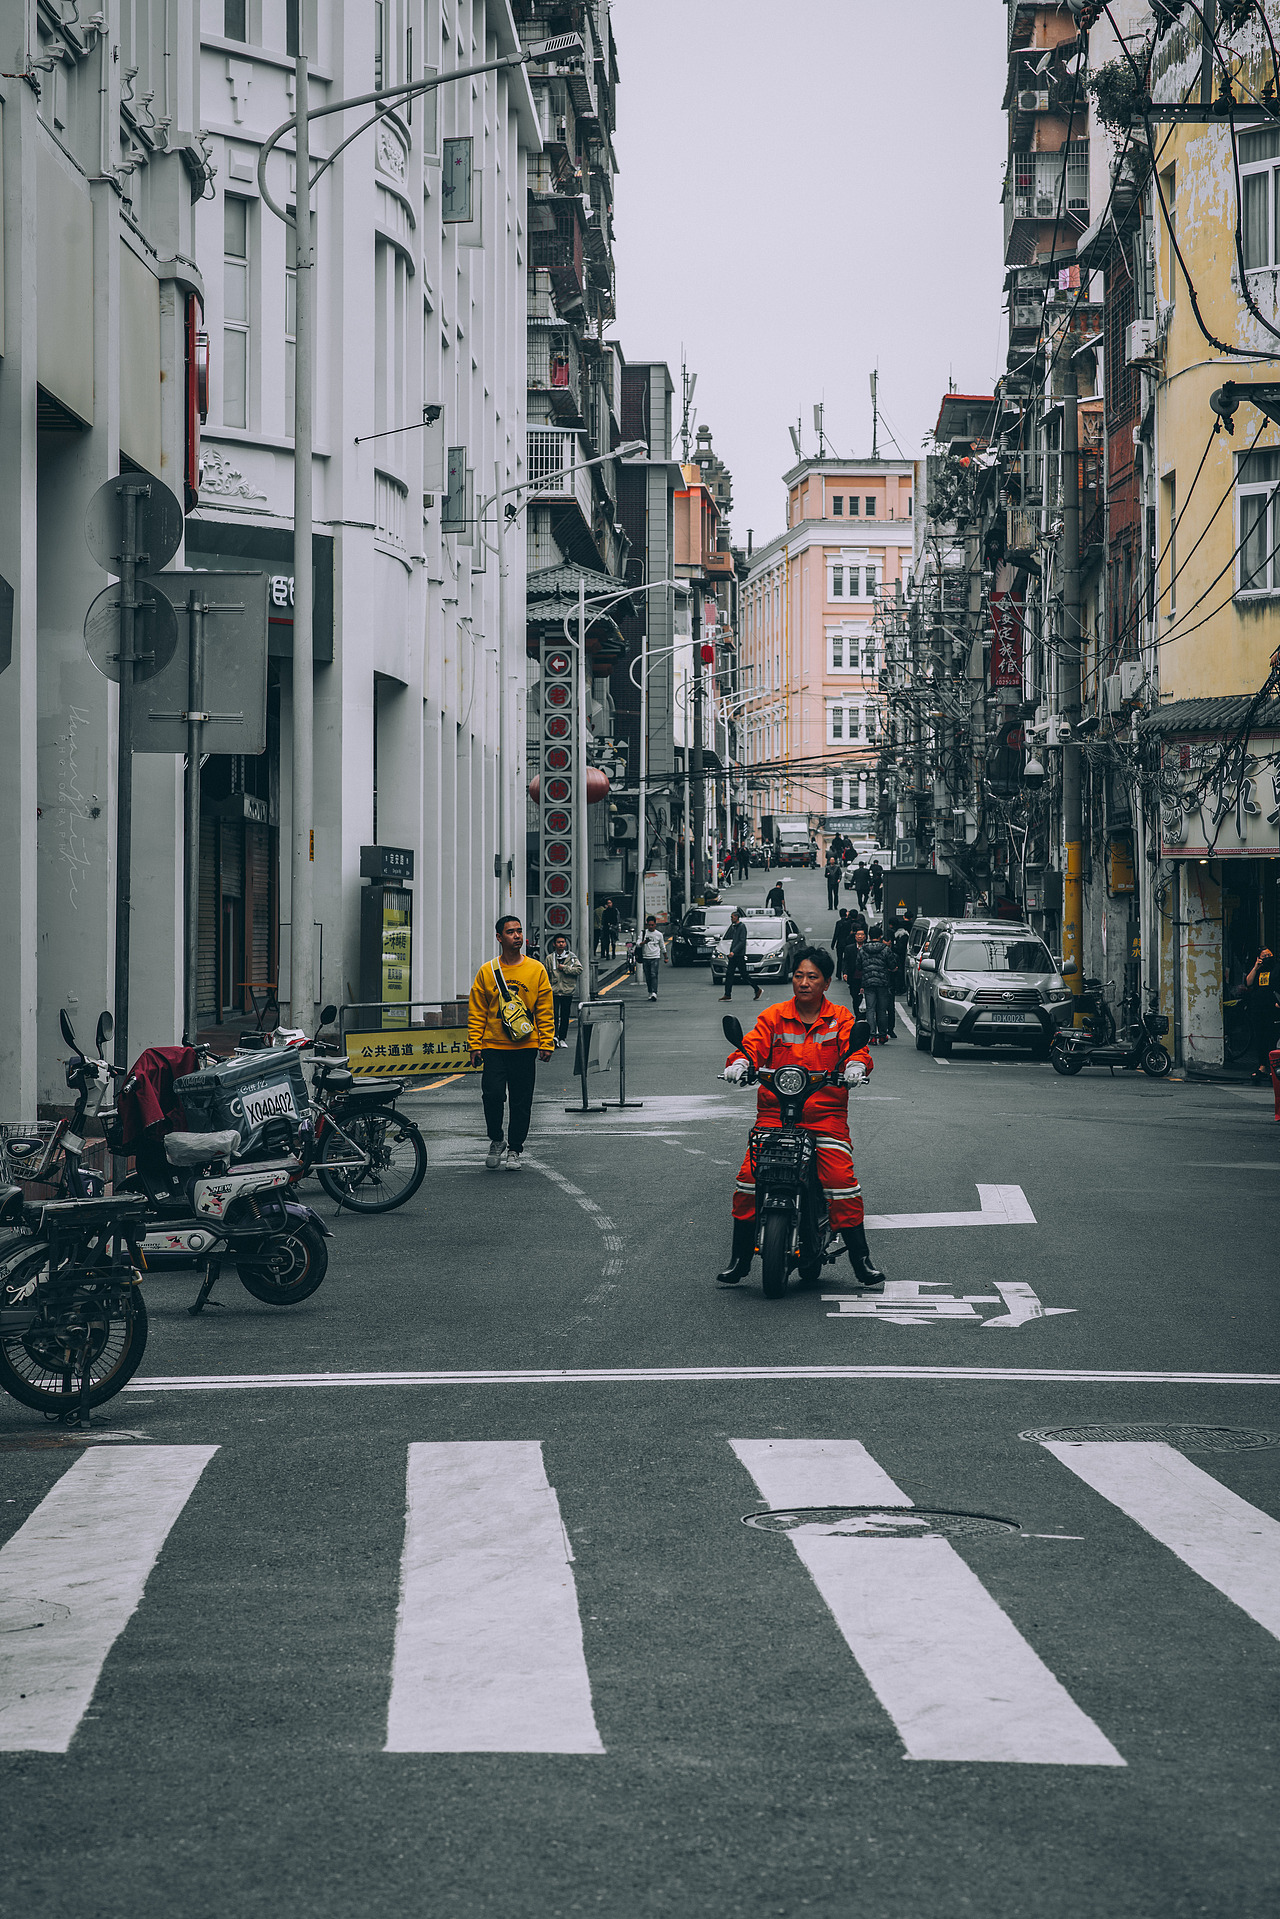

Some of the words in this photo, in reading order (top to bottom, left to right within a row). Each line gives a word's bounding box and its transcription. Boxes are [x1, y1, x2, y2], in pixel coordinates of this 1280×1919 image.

[549, 687, 568, 926] 老虎城状元美食街
[898, 842, 911, 864] P
[361, 1043, 414, 1058] 公共通道
[245, 1091, 294, 1125] X040402
